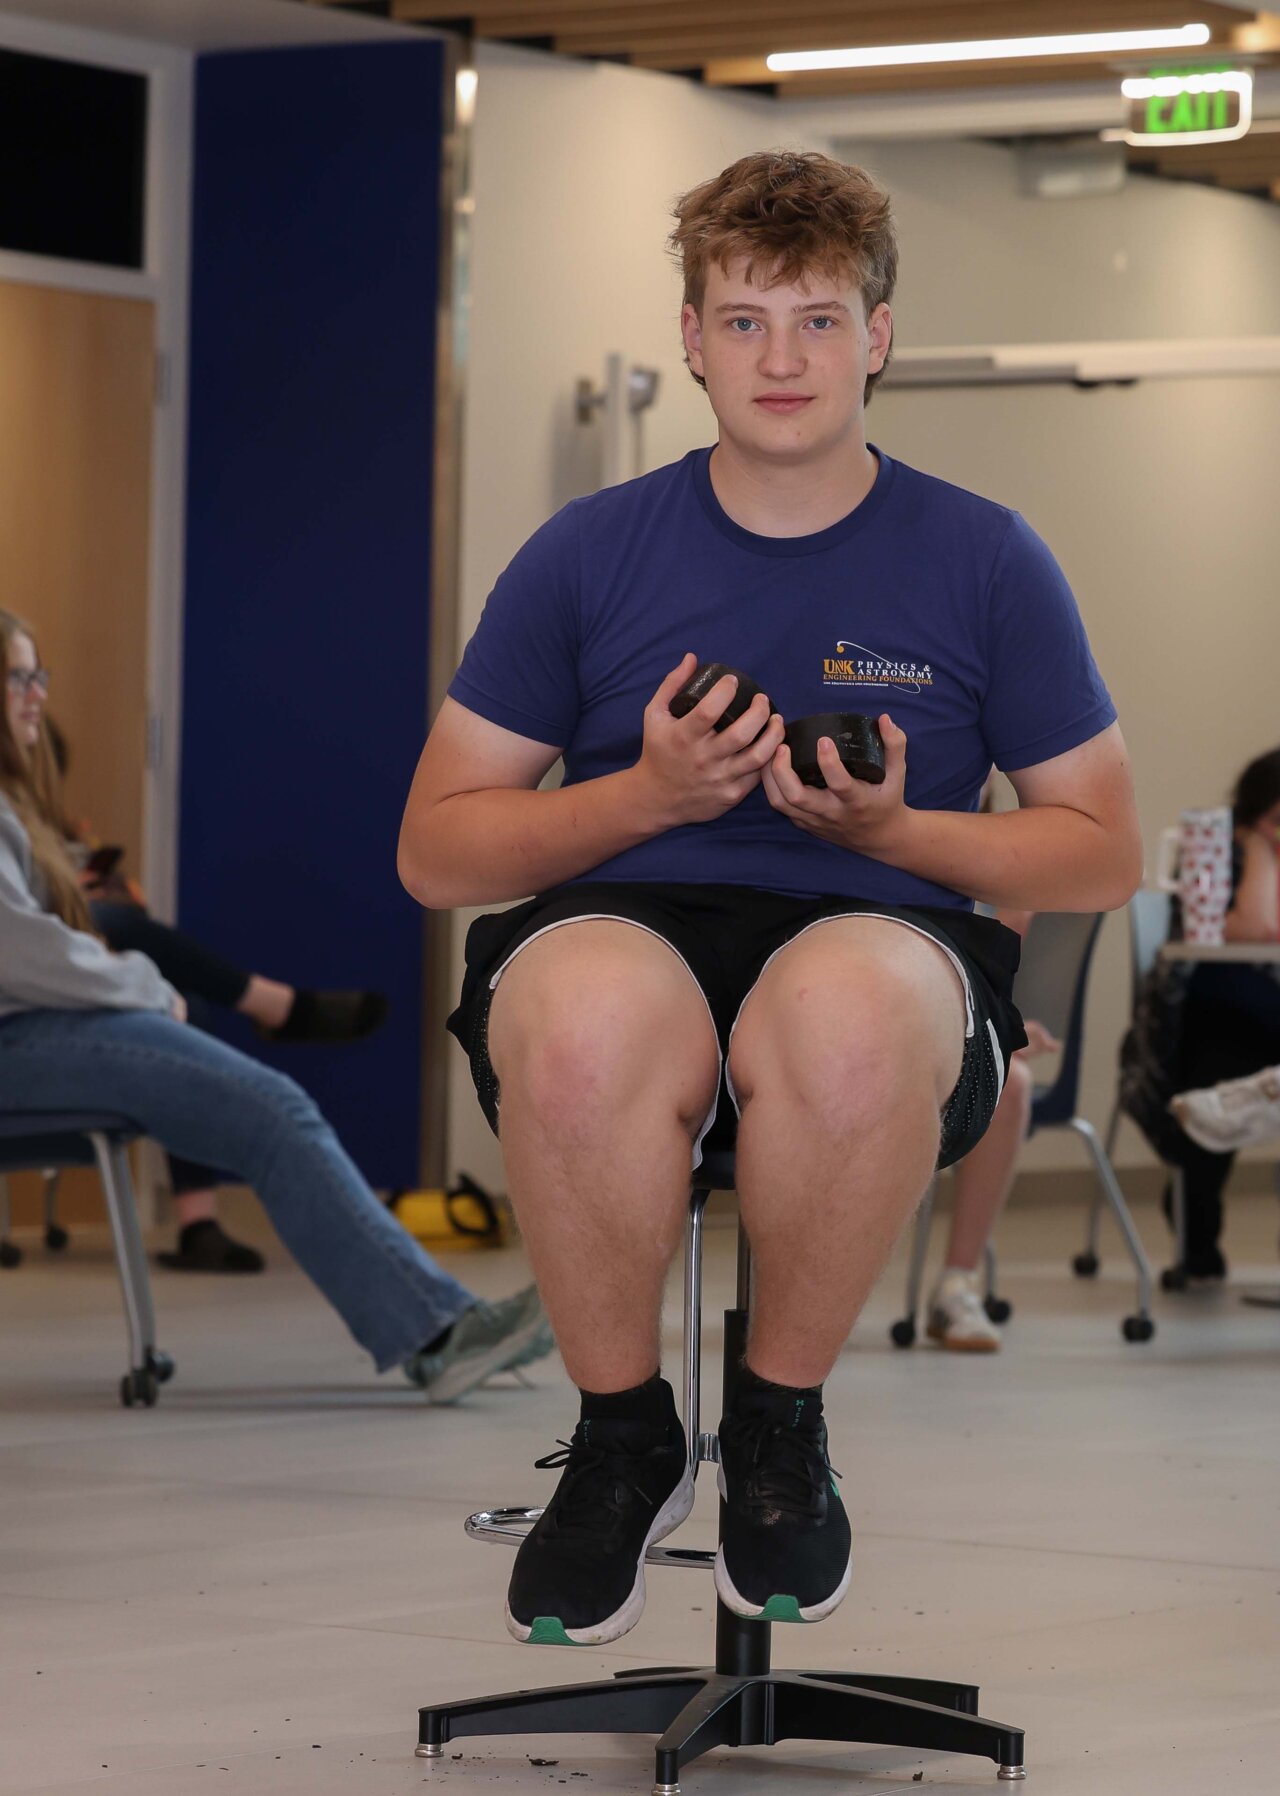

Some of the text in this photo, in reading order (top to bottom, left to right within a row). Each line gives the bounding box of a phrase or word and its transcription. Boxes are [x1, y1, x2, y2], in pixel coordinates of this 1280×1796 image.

[823, 659, 855, 675] UNK
[857, 661, 917, 670] PHYSICS
[823, 674, 877, 682] ENGINEERING
[879, 675, 933, 685] FOUNDATIONS
[858, 668, 933, 680] ASTRONOMY
